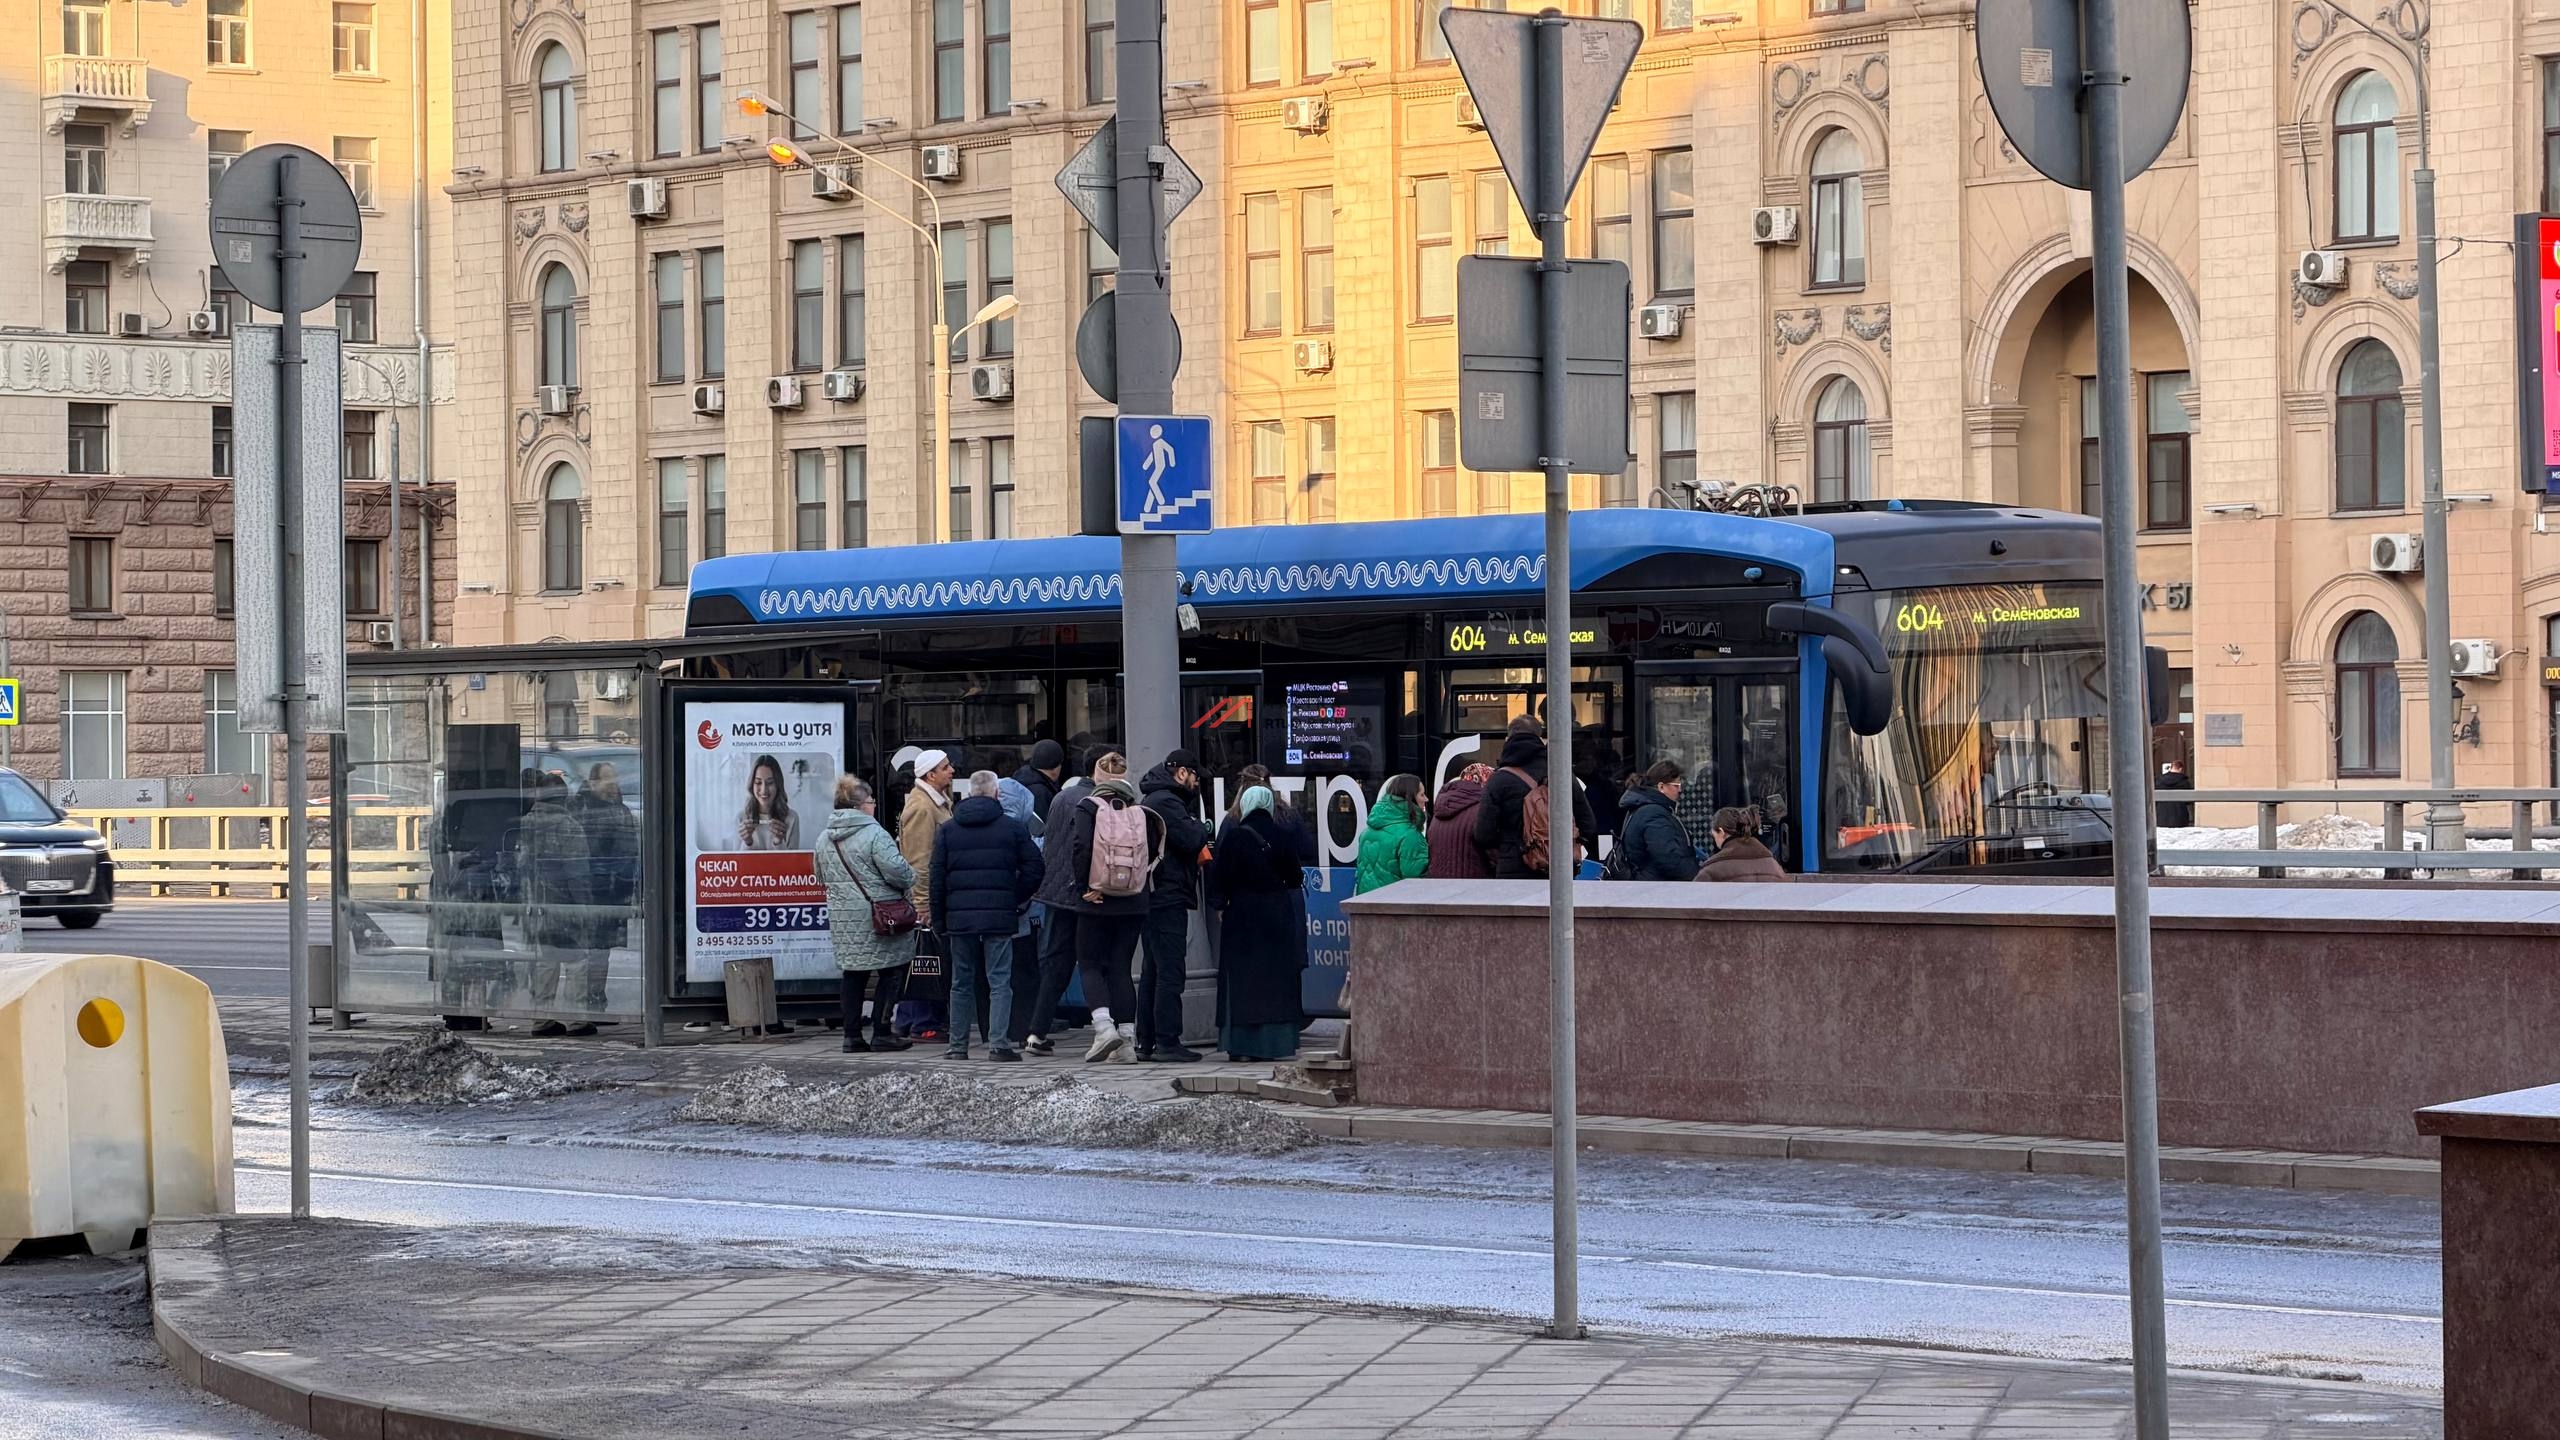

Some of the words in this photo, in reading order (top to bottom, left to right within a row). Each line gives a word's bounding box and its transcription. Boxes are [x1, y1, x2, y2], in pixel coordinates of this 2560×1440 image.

[1897, 604, 1944, 631] 604
[1973, 611, 1987, 622] м.
[1992, 606, 2080, 622] Семёновская
[1450, 626, 1486, 651] 604
[1508, 633, 1520, 644] м.
[1524, 630, 1594, 644] Семская
[732, 723, 774, 737] мать
[779, 723, 788, 736] и
[793, 723, 832, 740] дитя
[699, 860, 738, 872] ЧЕКАП
[700, 875, 738, 888] «ХОЧУ
[740, 875, 776, 887] СТАТЬ
[779, 874, 820, 886] МАМО
[745, 908, 771, 928] 39
[697, 936, 704, 947] 8
[706, 936, 725, 947] 495
[726, 936, 745, 946] 432
[746, 935, 760, 946] 55
[761, 935, 774, 945] 55
